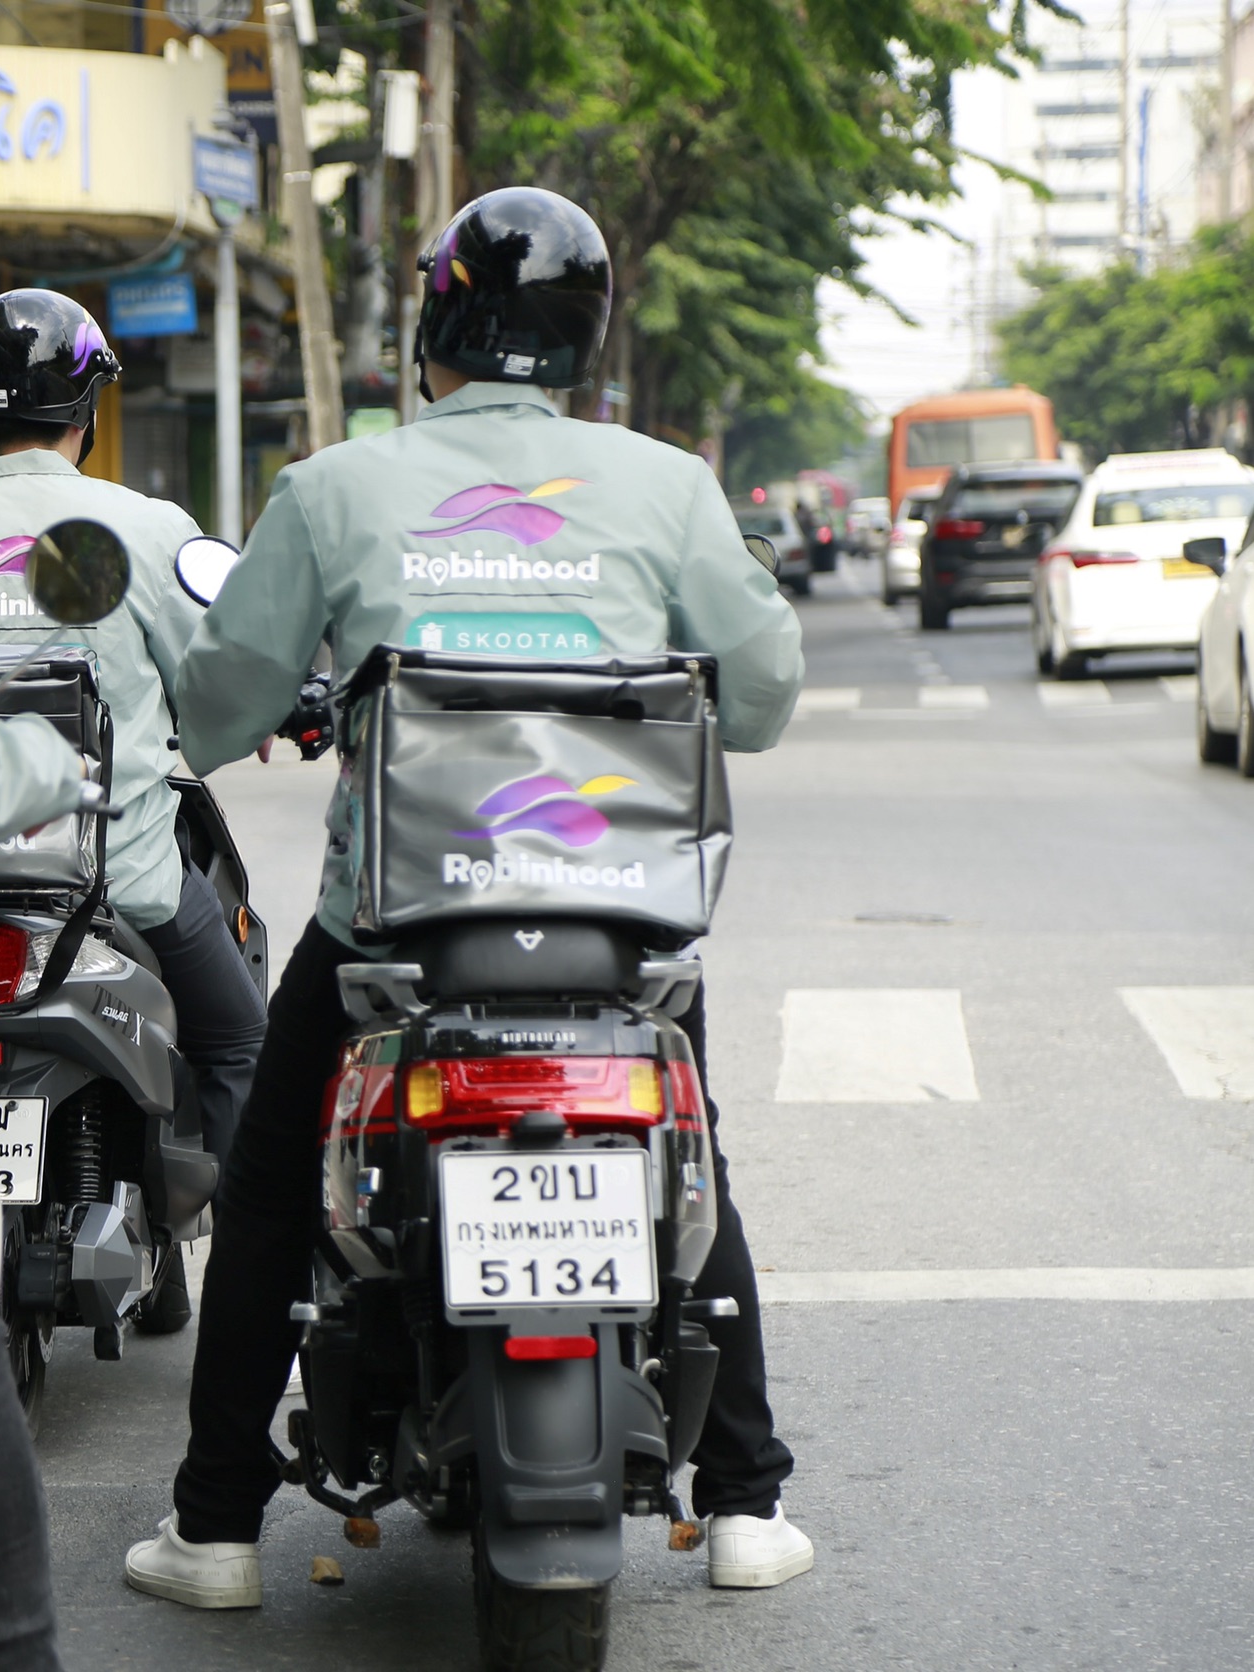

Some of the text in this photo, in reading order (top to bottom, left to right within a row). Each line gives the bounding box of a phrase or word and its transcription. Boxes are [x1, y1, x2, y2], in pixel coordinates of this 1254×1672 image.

[403, 549, 601, 586] Robinhood
[457, 632, 589, 649] SKOOTAR
[443, 851, 646, 890] Robinhood
[458, 1218, 639, 1249] กรุงเทพมหานคร
[480, 1257, 621, 1297] 5134
